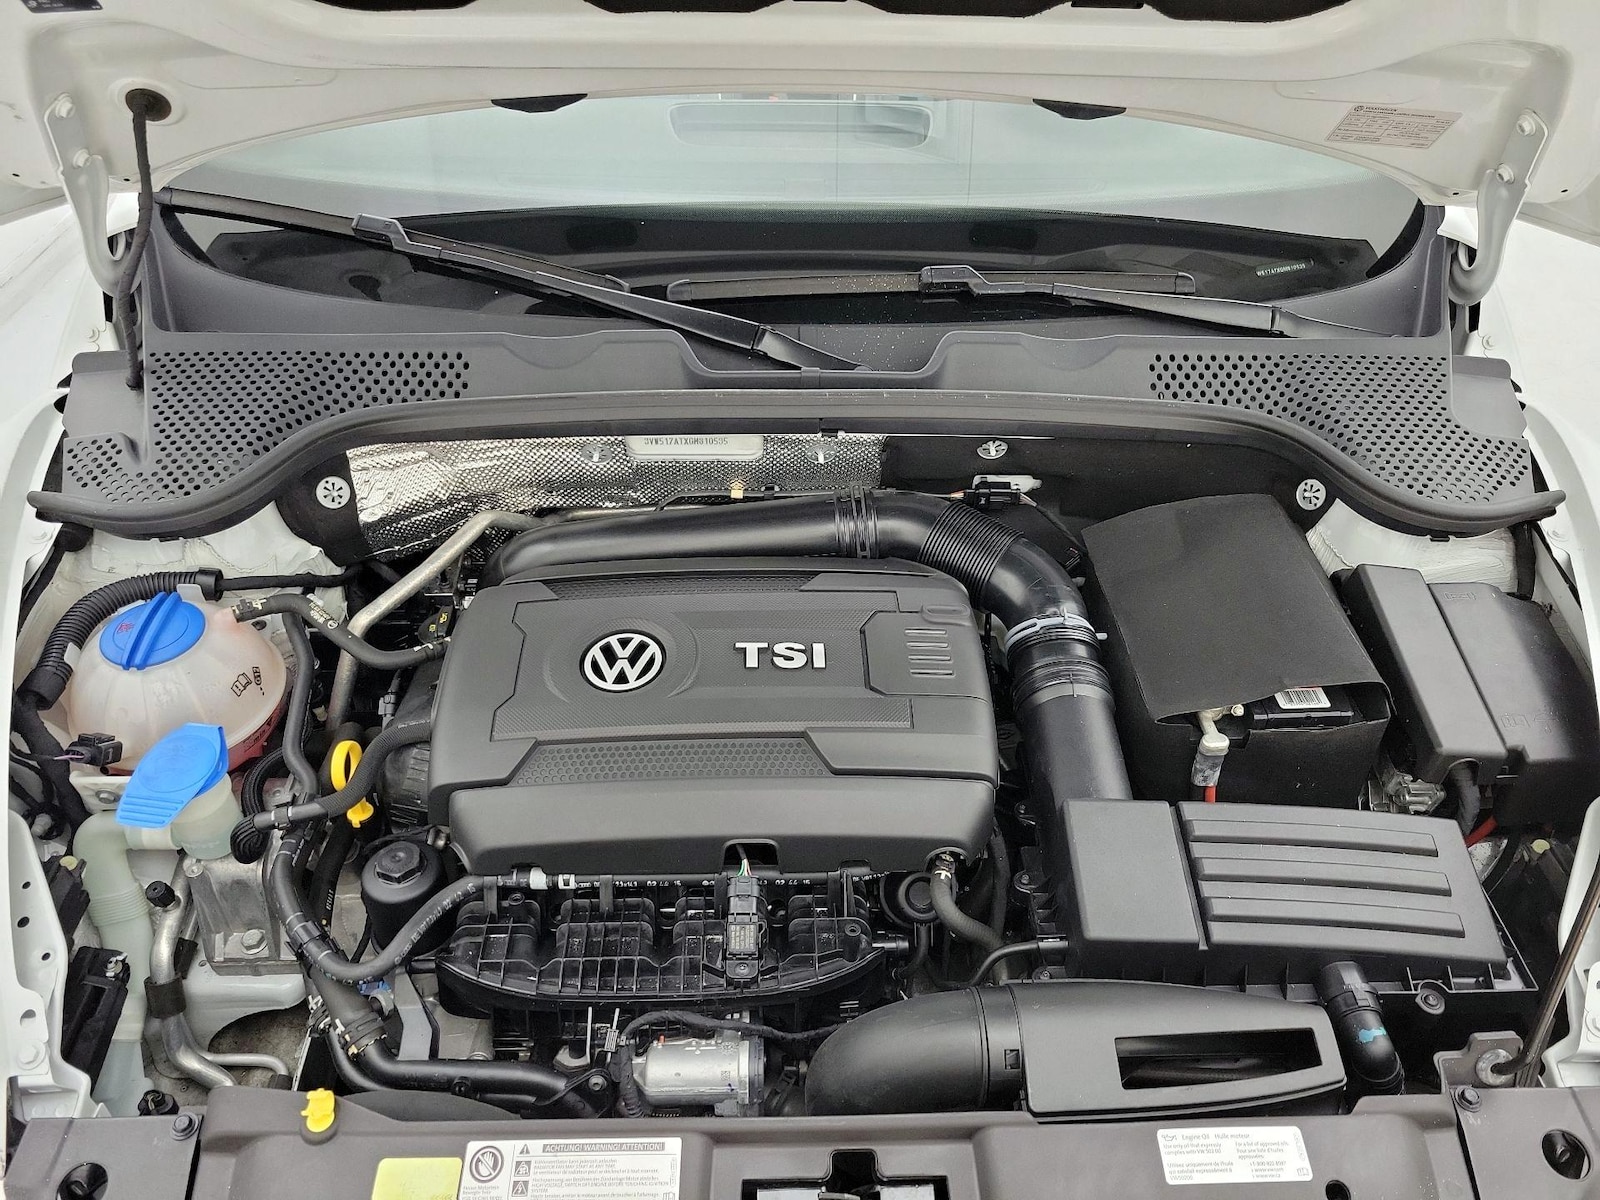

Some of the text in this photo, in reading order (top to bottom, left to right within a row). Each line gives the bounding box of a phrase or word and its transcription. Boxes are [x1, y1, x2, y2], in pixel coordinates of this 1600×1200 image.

[734, 642, 827, 669] TSI
[545, 1142, 663, 1152] ACHTUNG! WARNING! ATTENTION!
